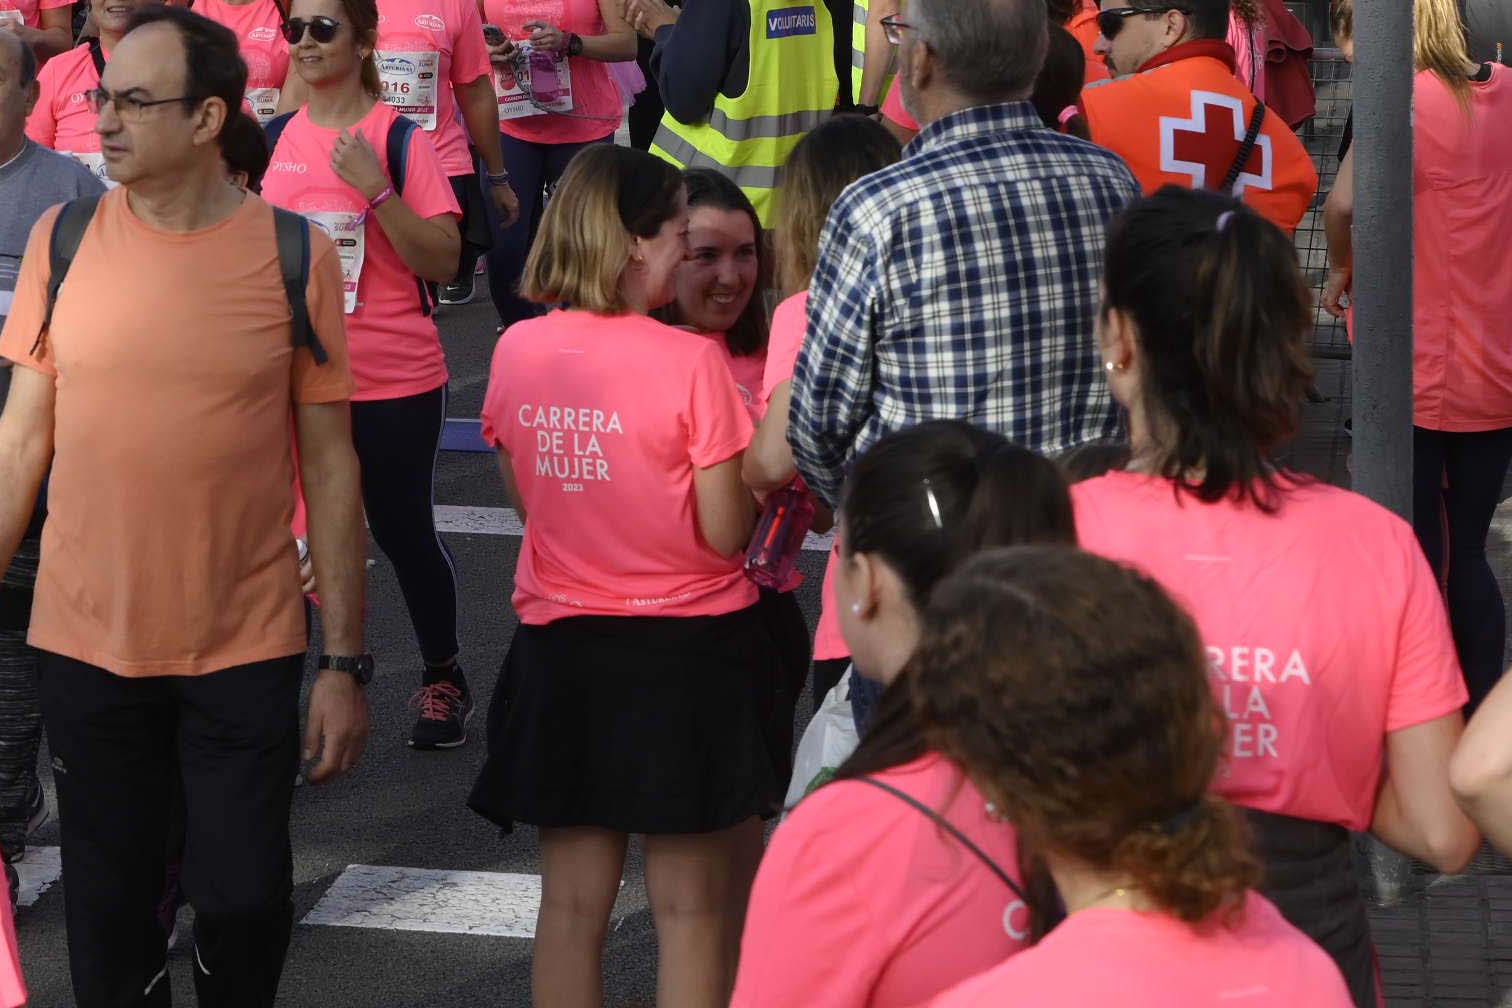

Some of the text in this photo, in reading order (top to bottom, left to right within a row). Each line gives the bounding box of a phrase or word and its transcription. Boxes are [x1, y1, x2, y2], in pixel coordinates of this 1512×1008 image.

[517, 403, 624, 435] CARRERA
[537, 430, 604, 457] DE LA
[535, 457, 612, 481] MUJER
[1205, 645, 1312, 686] RERA
[1223, 685, 1272, 720] LA
